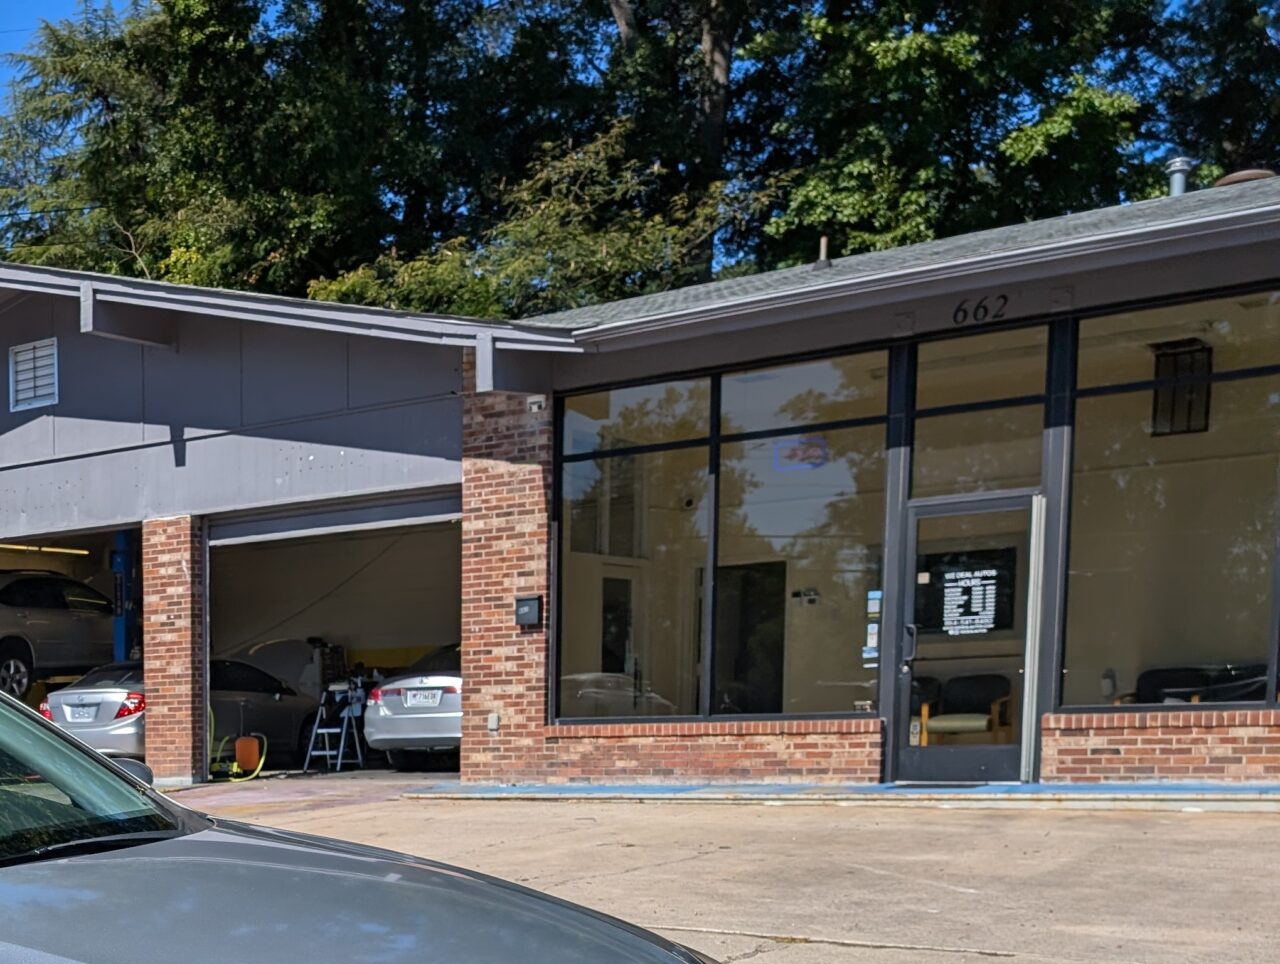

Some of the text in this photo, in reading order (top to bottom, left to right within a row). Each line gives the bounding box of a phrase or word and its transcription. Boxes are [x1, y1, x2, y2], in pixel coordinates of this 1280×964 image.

[952, 294, 1008, 324] 662
[973, 569, 997, 578] AUTOS
[958, 578, 981, 587] HOURS
